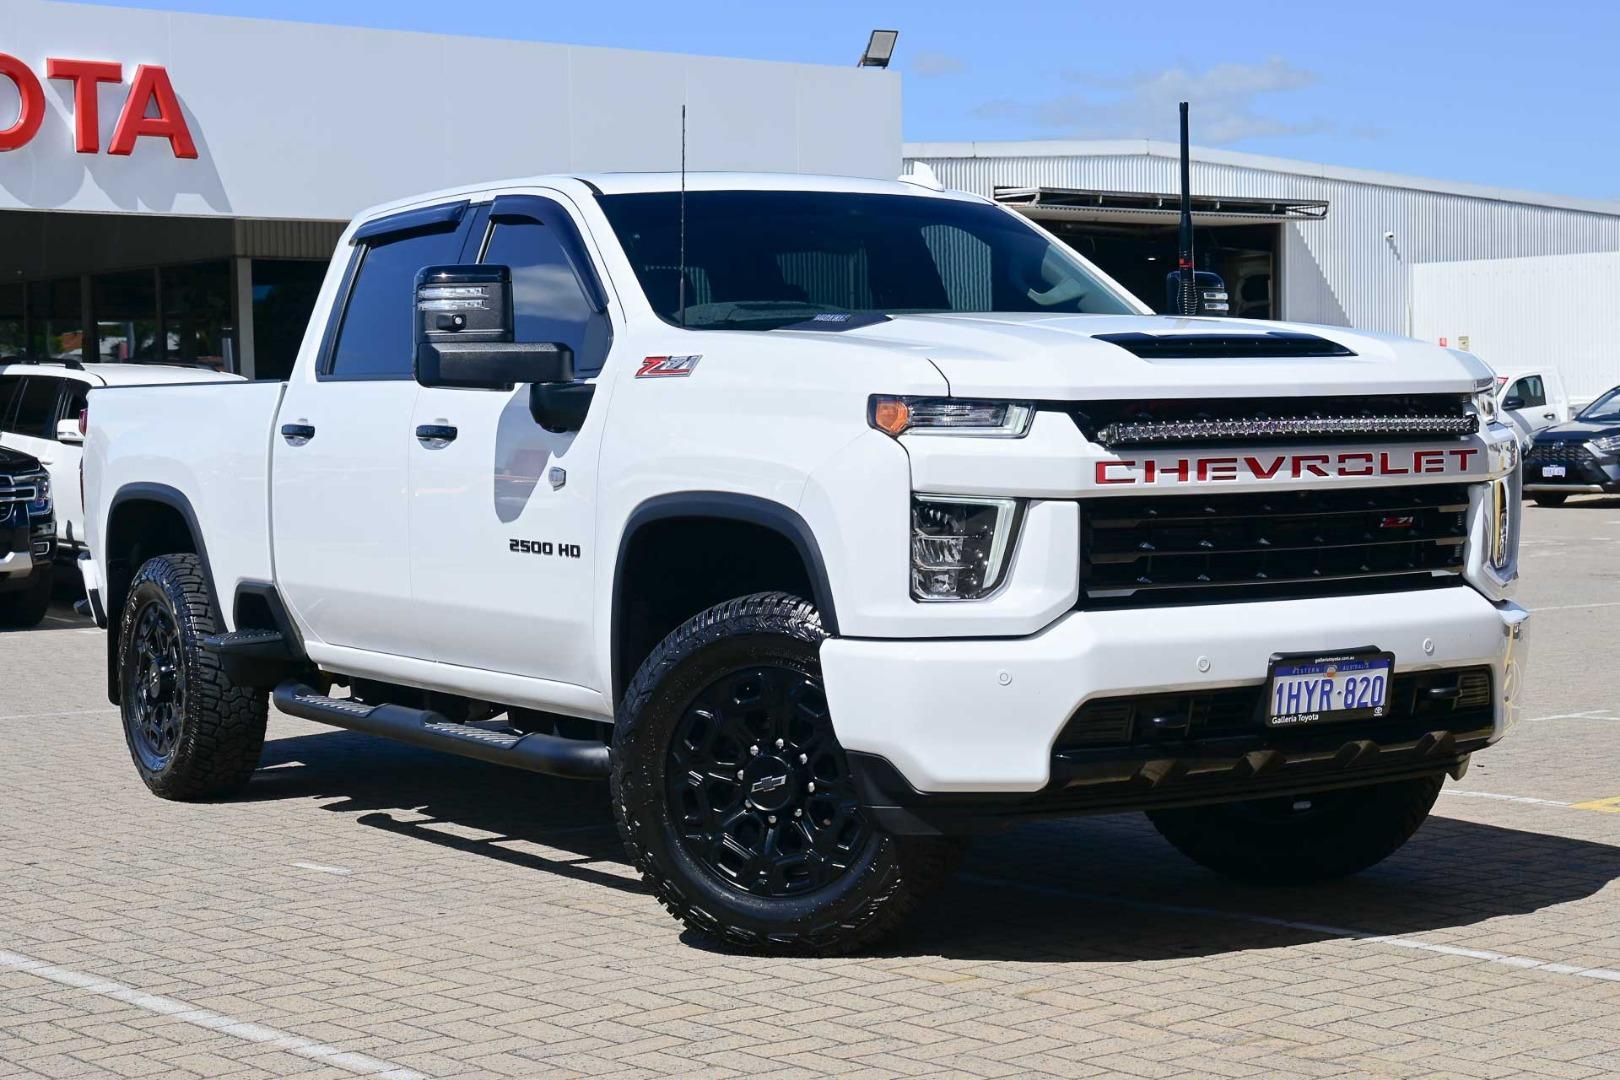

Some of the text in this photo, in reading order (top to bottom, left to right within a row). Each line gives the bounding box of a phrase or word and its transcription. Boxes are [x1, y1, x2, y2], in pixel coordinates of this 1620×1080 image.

[634, 354, 703, 379] Z71
[1096, 449, 1478, 484] CHEVROLET
[509, 539, 581, 559] 2500 HD
[1272, 713, 1319, 724] Galleria Toyota
